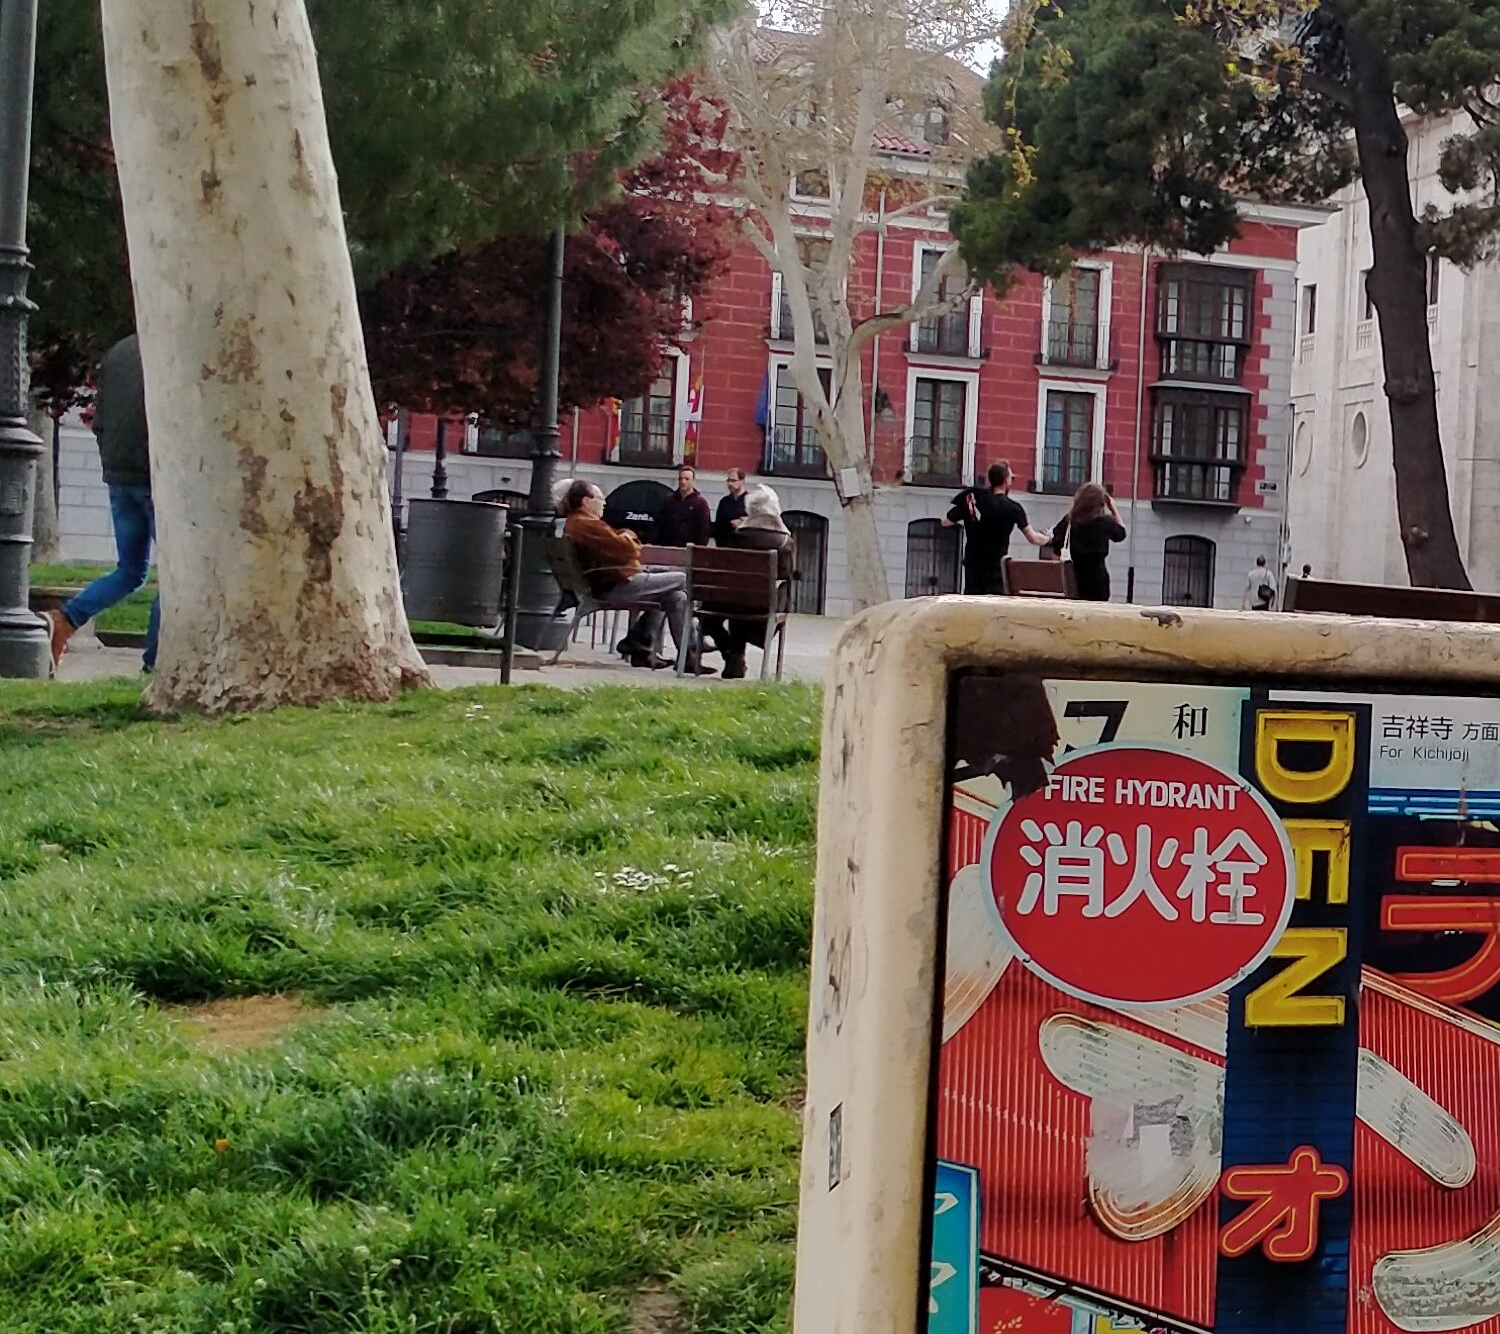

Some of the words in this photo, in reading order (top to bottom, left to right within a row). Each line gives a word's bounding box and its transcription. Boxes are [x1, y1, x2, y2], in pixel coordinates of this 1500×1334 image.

[1172, 703, 1209, 739] 和
[1381, 715, 1454, 741] 吉祥寺
[1462, 722, 1500, 742] 方面
[1380, 745, 1403, 759] For
[1045, 775, 1105, 804] FIRE
[1115, 779, 1242, 811] HYDRANT
[1016, 819, 1268, 926] 消火栓
